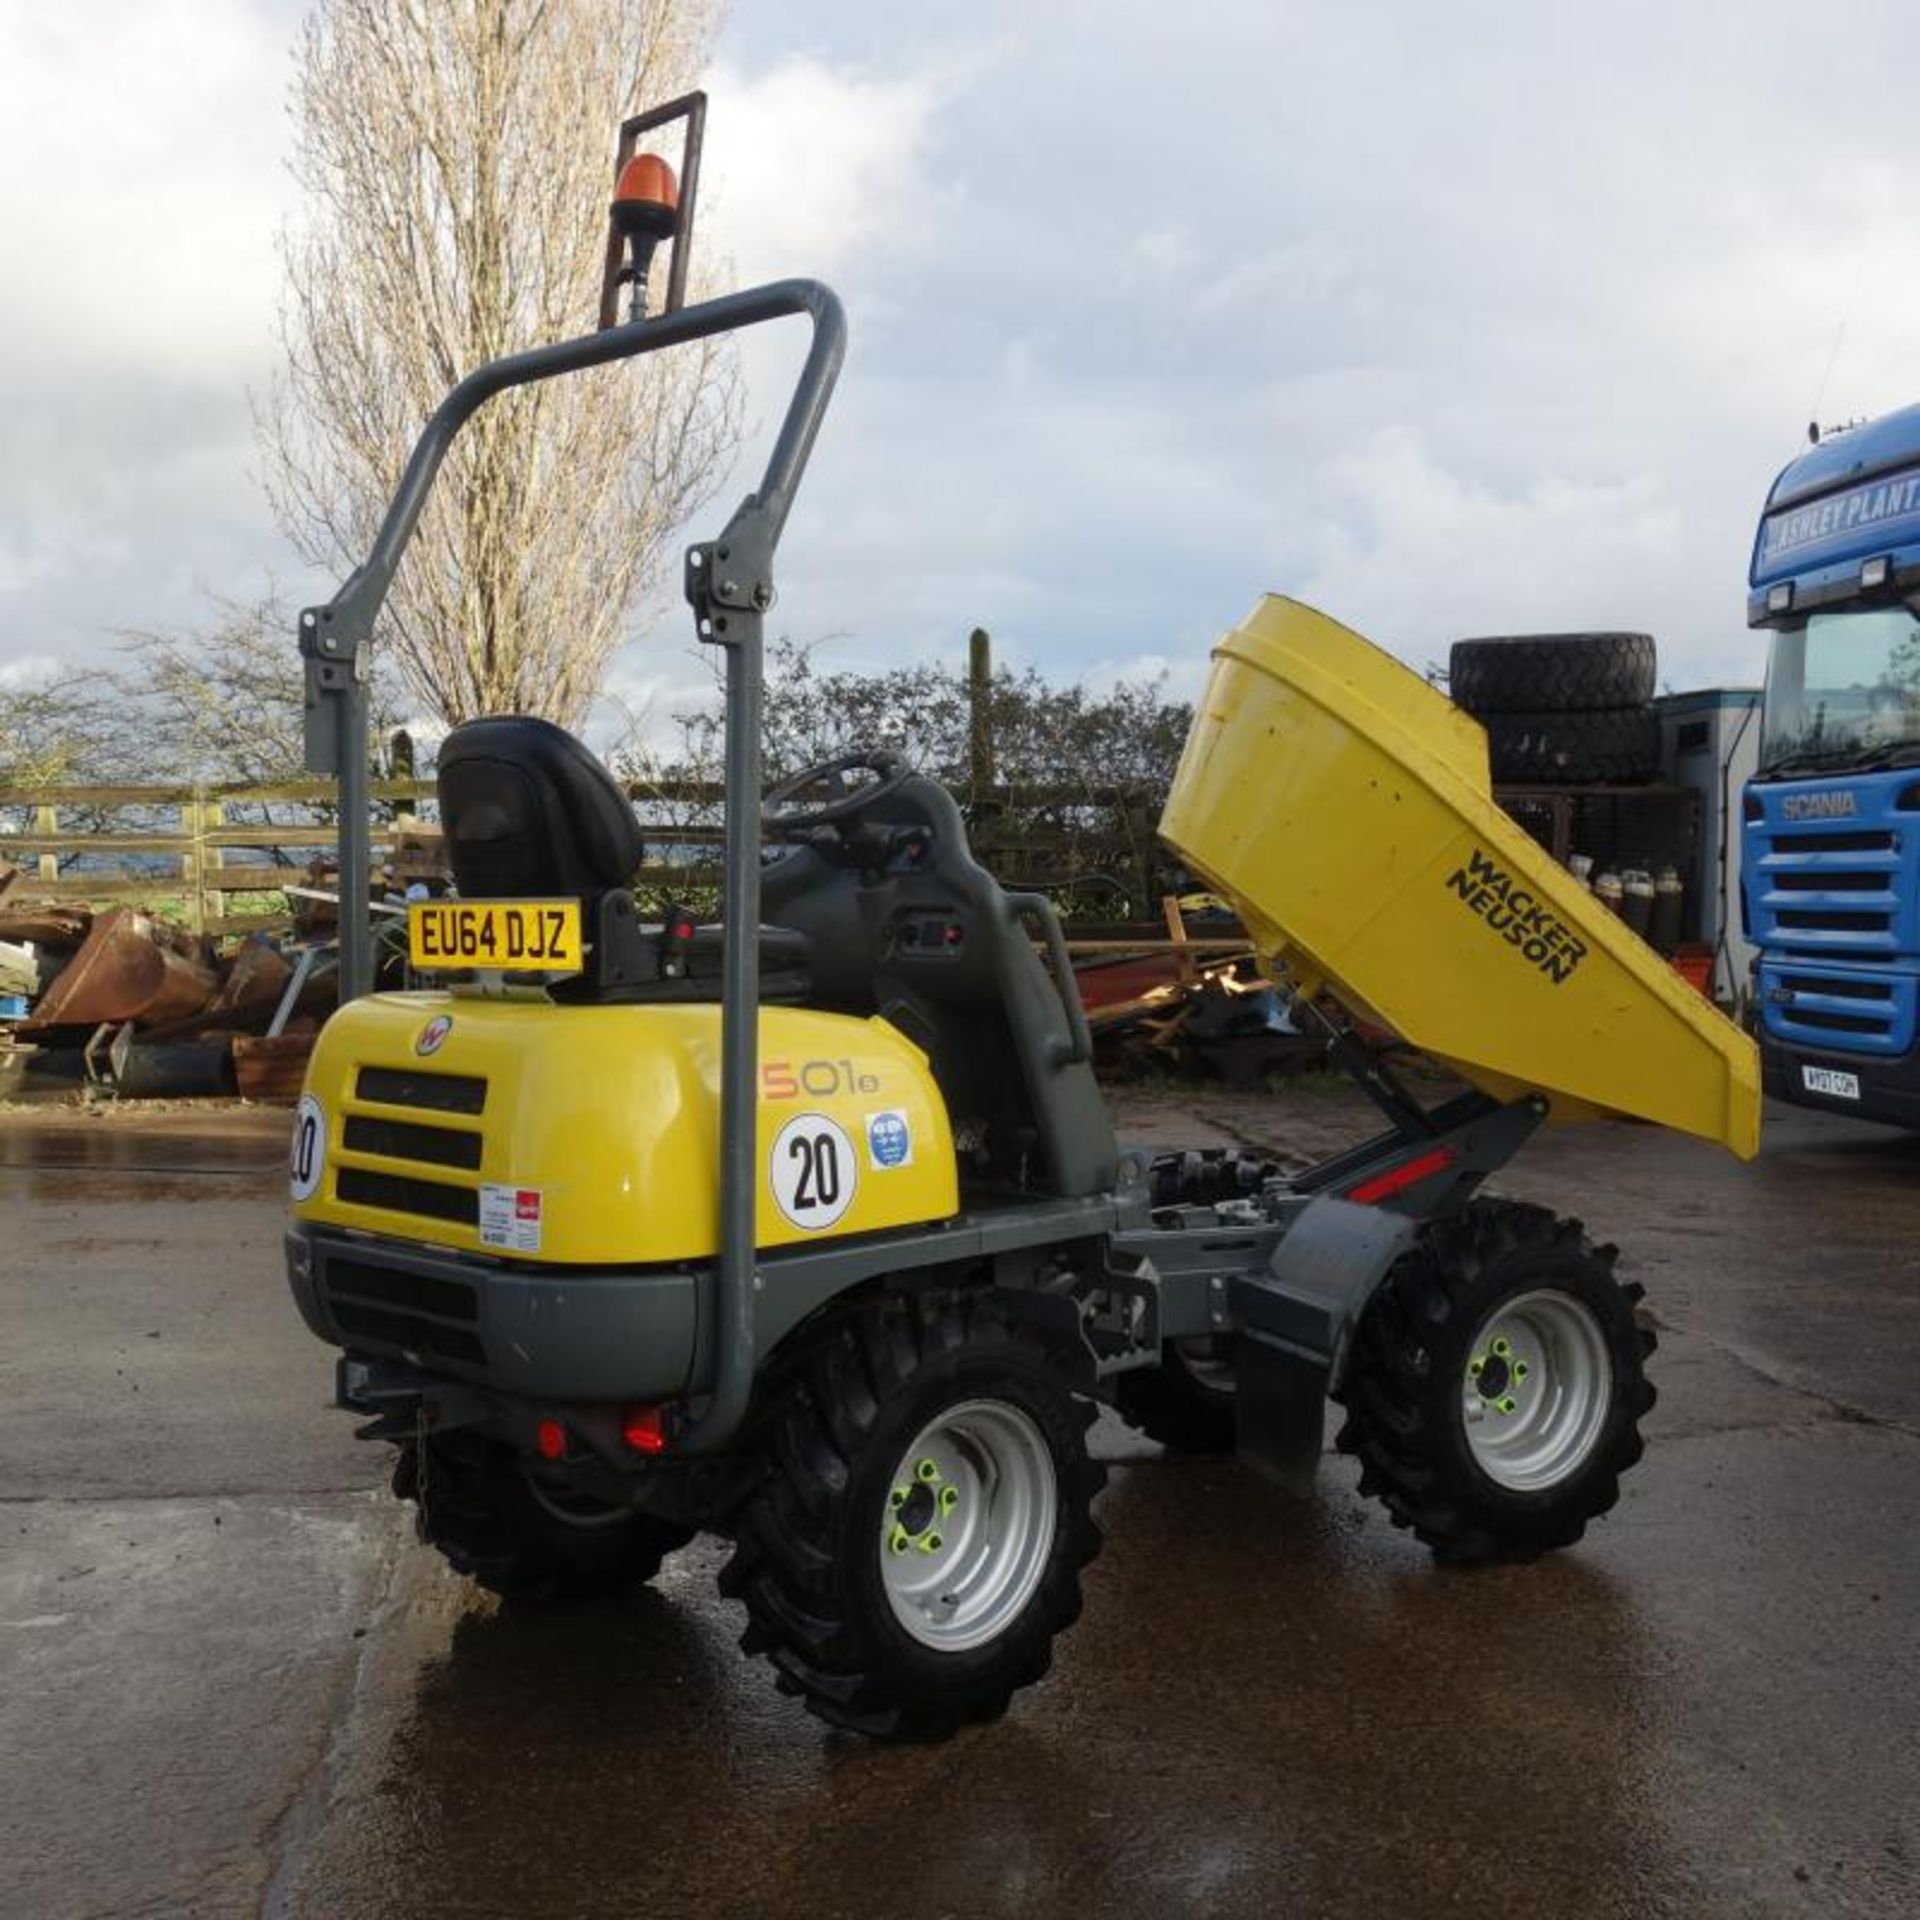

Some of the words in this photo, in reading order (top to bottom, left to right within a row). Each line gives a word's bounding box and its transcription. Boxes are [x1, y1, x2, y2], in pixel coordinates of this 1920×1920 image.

[1847, 479, 1918, 526] PLANT
[1783, 791, 1857, 820] SCANIA
[421, 909, 497, 957] EU64
[506, 910, 567, 959] DJZ
[1445, 868, 1573, 984] NEUSON
[1468, 848, 1587, 969] WACKER
[789, 1132, 839, 1210] 20
